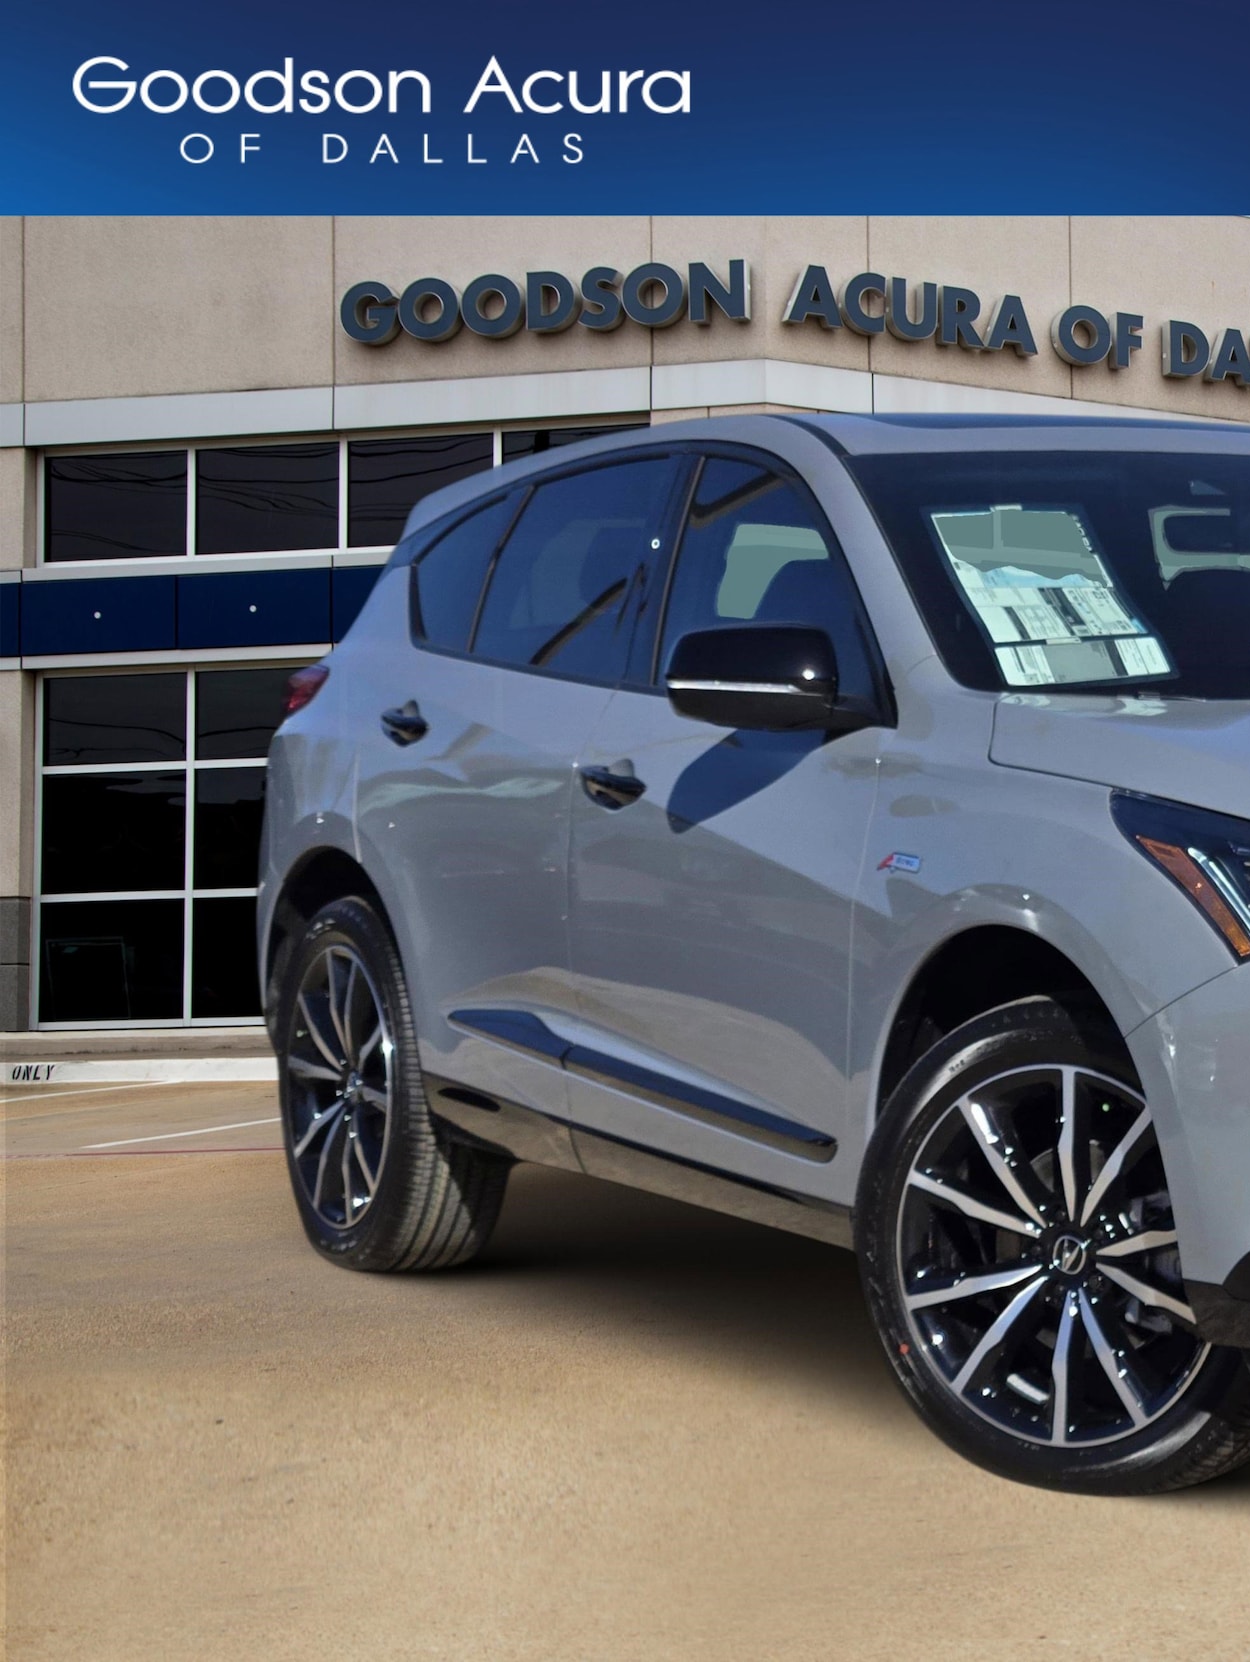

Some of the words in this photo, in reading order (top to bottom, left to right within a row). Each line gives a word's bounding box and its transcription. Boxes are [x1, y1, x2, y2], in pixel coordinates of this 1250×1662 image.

[340, 258, 751, 346] GOODSON
[781, 264, 1038, 357] ACURA
[1051, 305, 1144, 370] OF
[11, 1064, 55, 1081] ONLY
